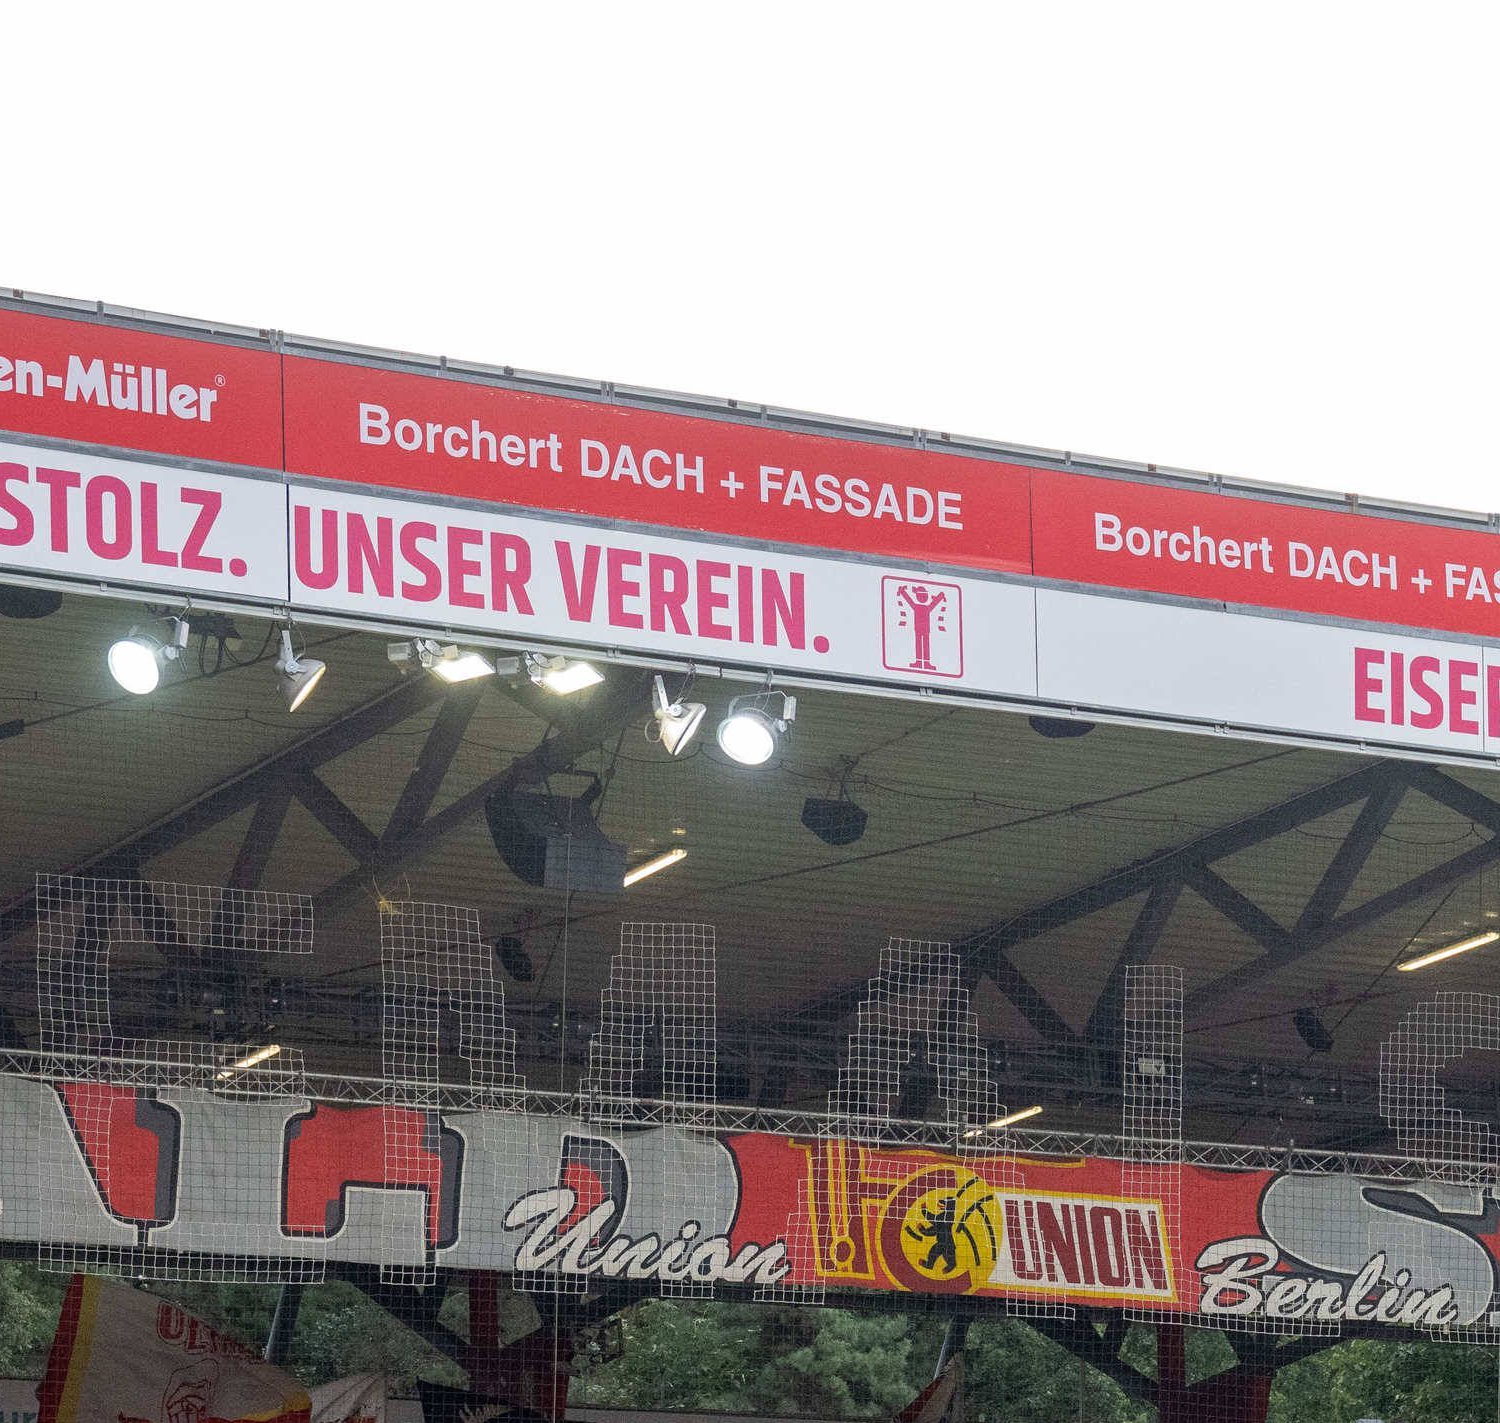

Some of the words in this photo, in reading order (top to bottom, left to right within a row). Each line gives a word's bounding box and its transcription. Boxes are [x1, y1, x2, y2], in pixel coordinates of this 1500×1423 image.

[358, 401, 564, 475] Borchert
[580, 439, 704, 494] DACH
[759, 465, 964, 532] FASSADE
[294, 503, 534, 618] UNSER
[554, 539, 831, 655] VEREIN.
[1093, 511, 1274, 576] Borchert
[1287, 541, 1397, 592] DACH
[504, 1187, 791, 1284] Union
[1003, 1196, 1167, 1292] UNION
[1196, 1237, 1458, 1329] Berlin
